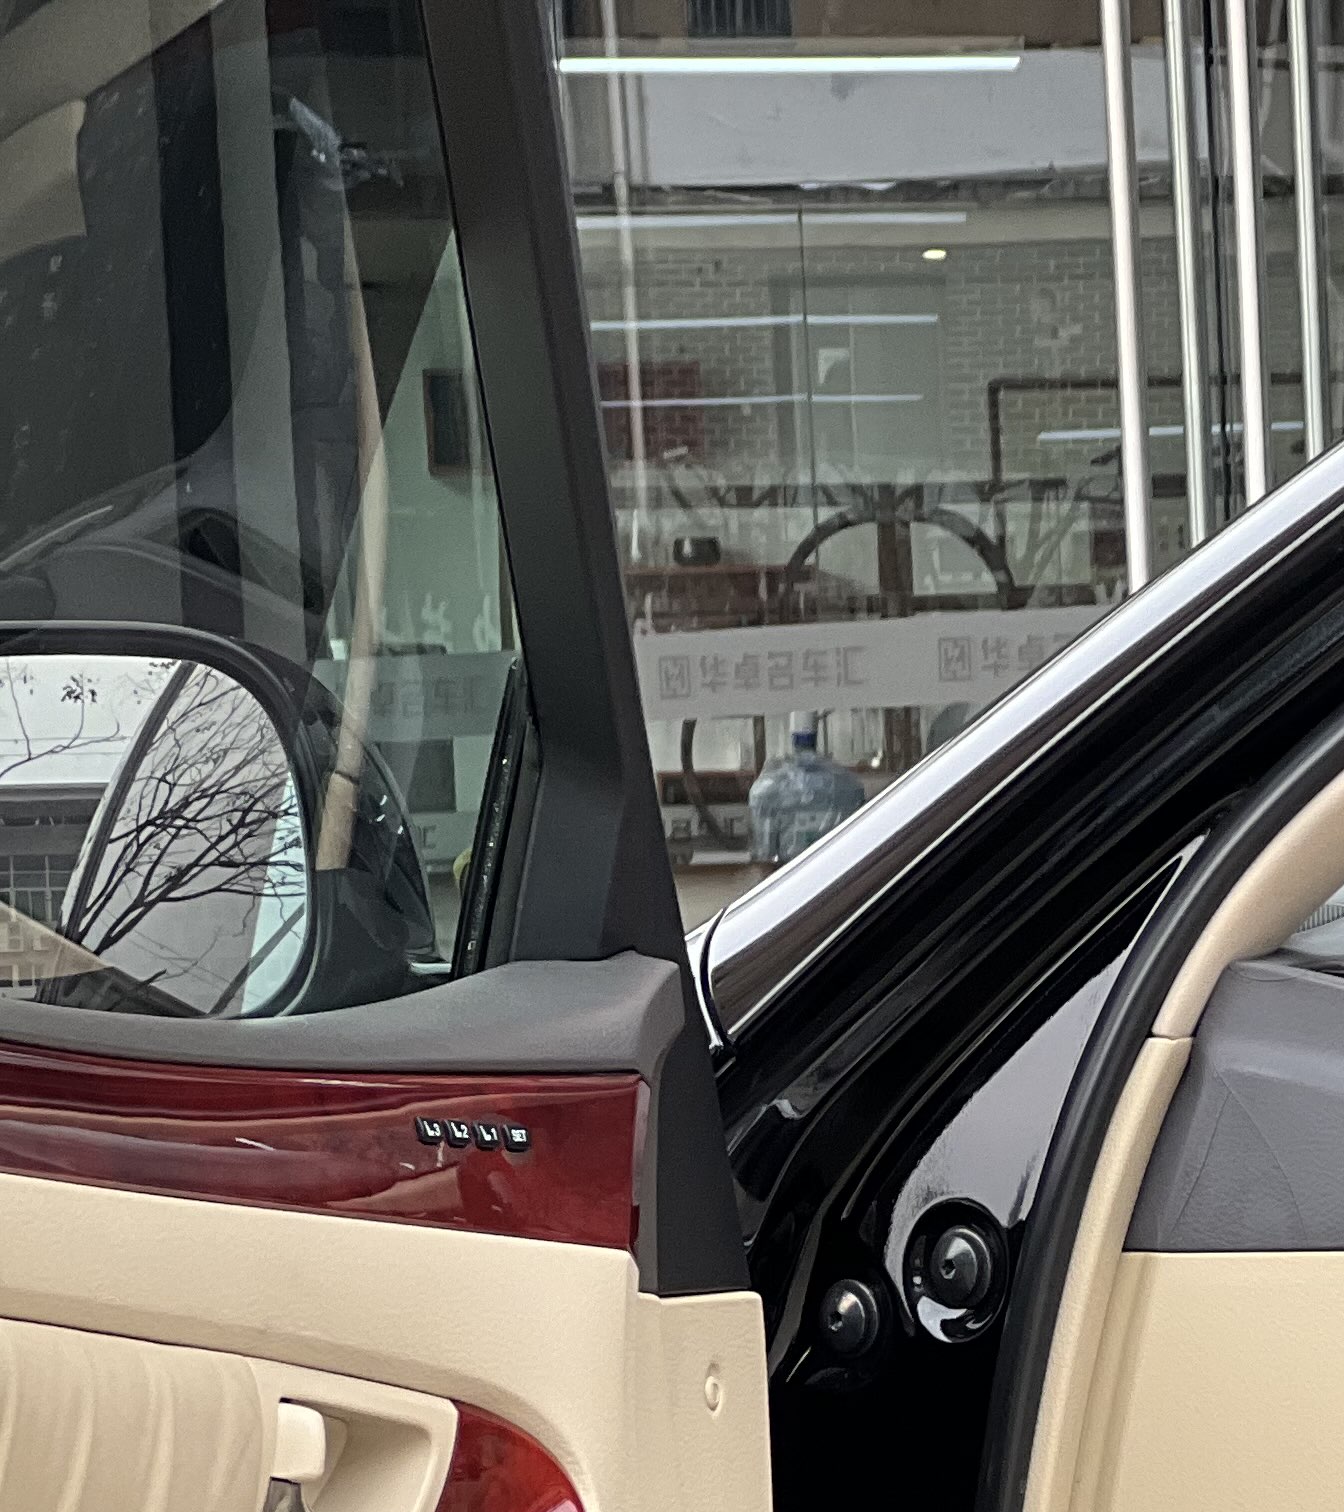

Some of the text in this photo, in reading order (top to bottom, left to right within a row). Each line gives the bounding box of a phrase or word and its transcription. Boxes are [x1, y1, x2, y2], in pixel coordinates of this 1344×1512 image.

[700, 646, 867, 692] 华卓名车汇
